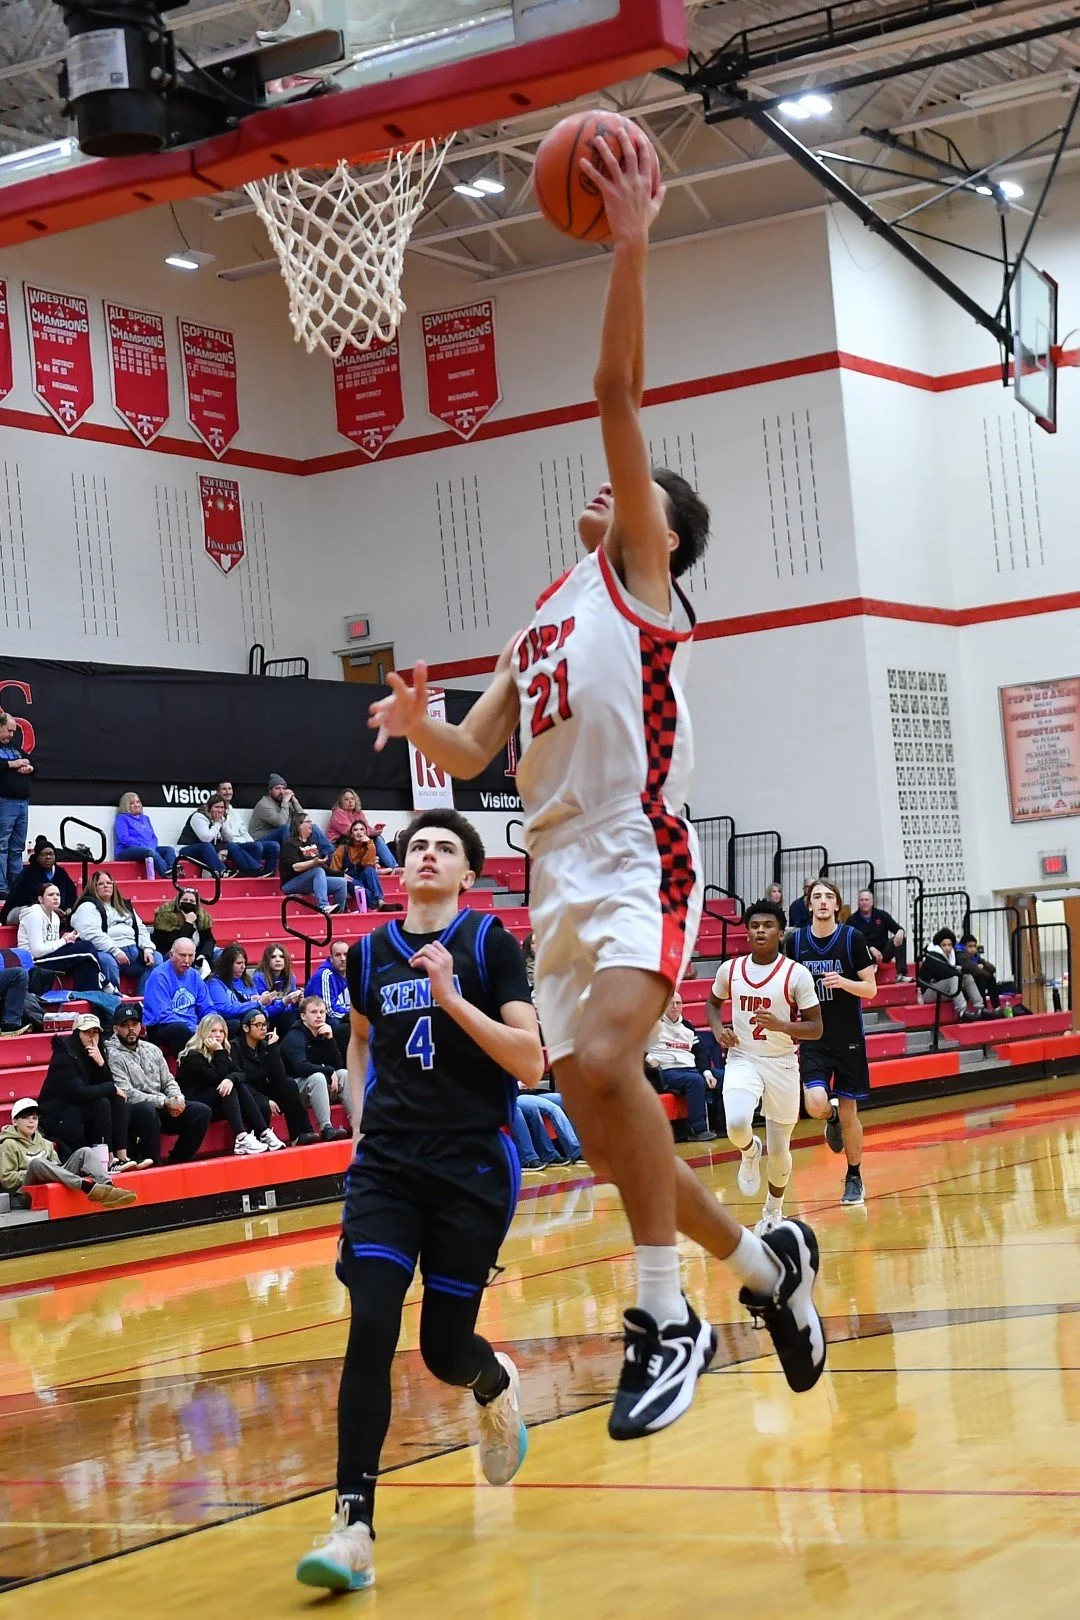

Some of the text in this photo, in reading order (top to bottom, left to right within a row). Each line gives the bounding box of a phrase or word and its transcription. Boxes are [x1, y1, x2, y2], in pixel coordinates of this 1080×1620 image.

[29, 289, 86, 315] WRESTLING
[31, 308, 88, 333] CHAMPIONS
[109, 306, 162, 332] ALL SPORTS
[423, 303, 491, 331] SWIMMING
[110, 324, 164, 348] CHAMPIONS
[182, 324, 233, 348] SOFTBALL
[424, 320, 492, 347] CHAMPIONS
[184, 341, 234, 365] CHAMPIONS
[334, 342, 398, 368] CHAMPIONS
[202, 485, 238, 500] STATE
[203, 478, 235, 490] SOFTBALL
[517, 615, 576, 673] TIPP
[527, 657, 574, 739] 21
[161, 784, 218, 805] Visitor
[480, 791, 524, 809] Visitor
[380, 973, 462, 1017] XEN
[739, 995, 772, 1012] TIPP
[749, 1016, 767, 1041] 2
[405, 1015, 436, 1071] 4
